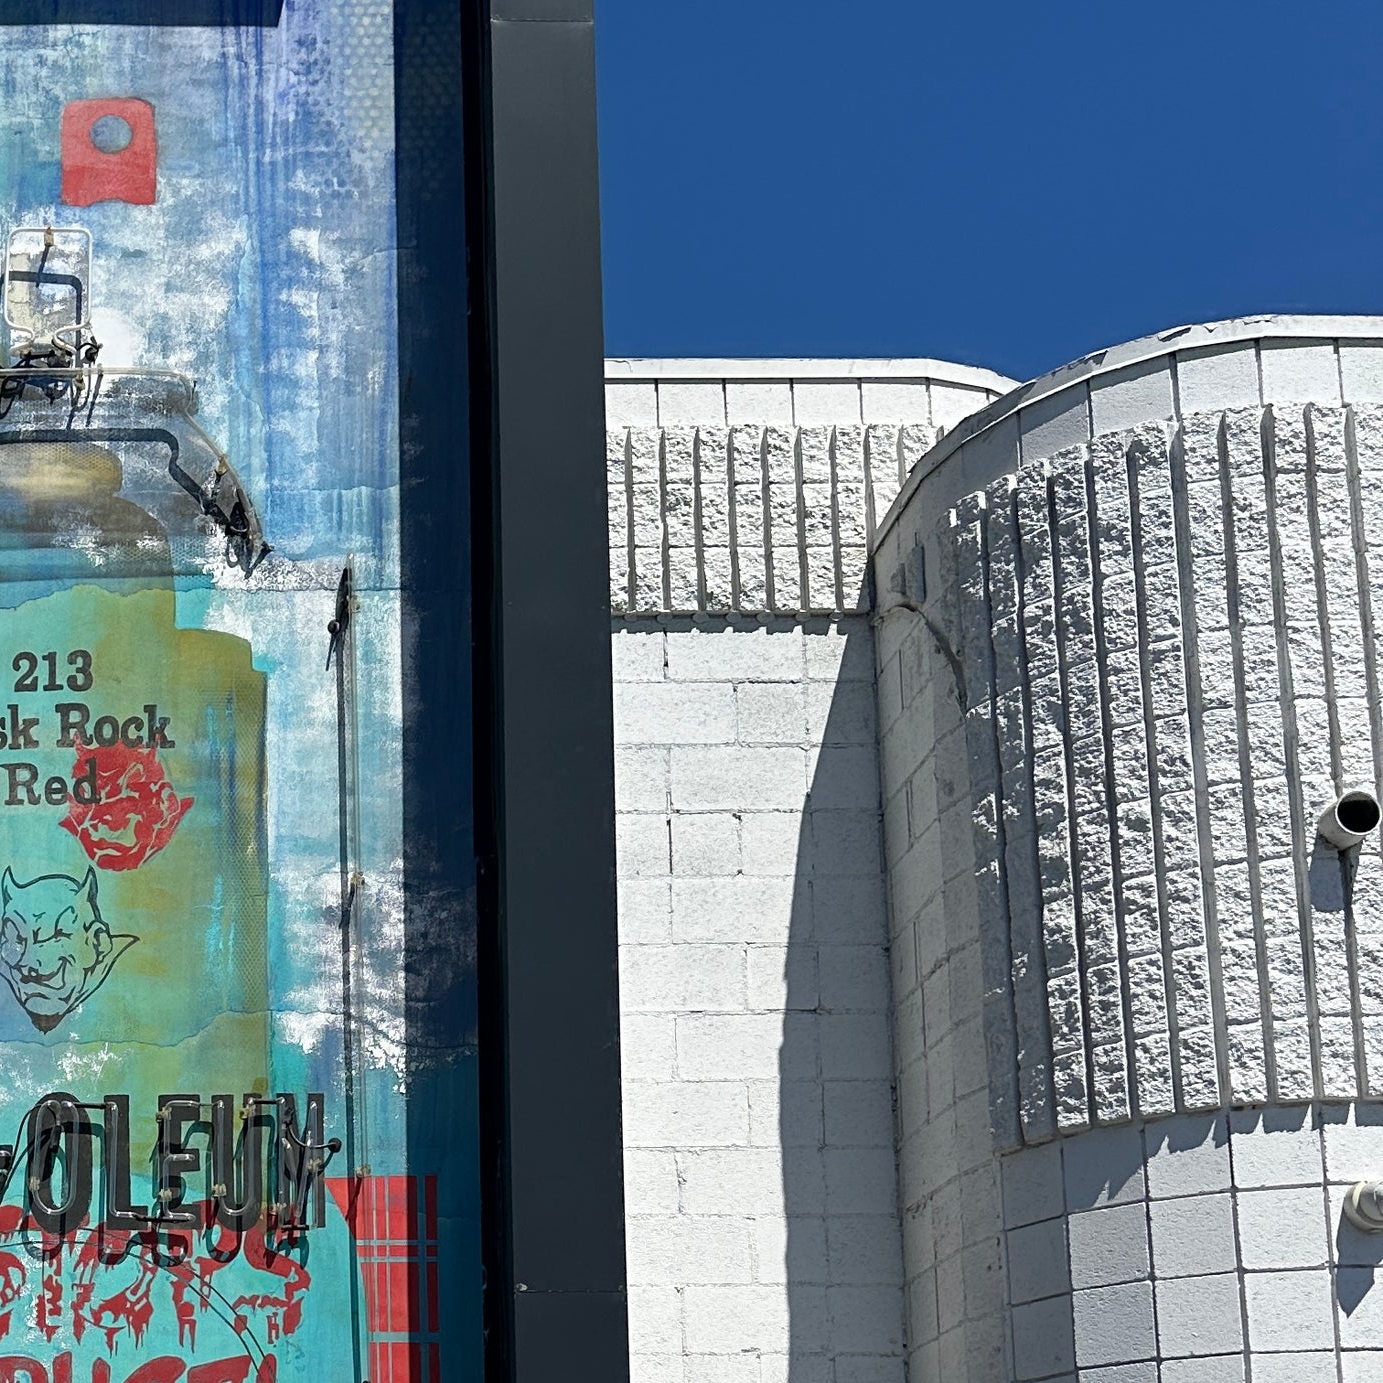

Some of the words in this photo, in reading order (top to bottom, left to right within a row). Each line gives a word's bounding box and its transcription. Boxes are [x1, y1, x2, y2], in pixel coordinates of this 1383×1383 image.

[12, 649, 94, 692] 213
[55, 702, 175, 749] Rock
[0, 757, 102, 806] Red
